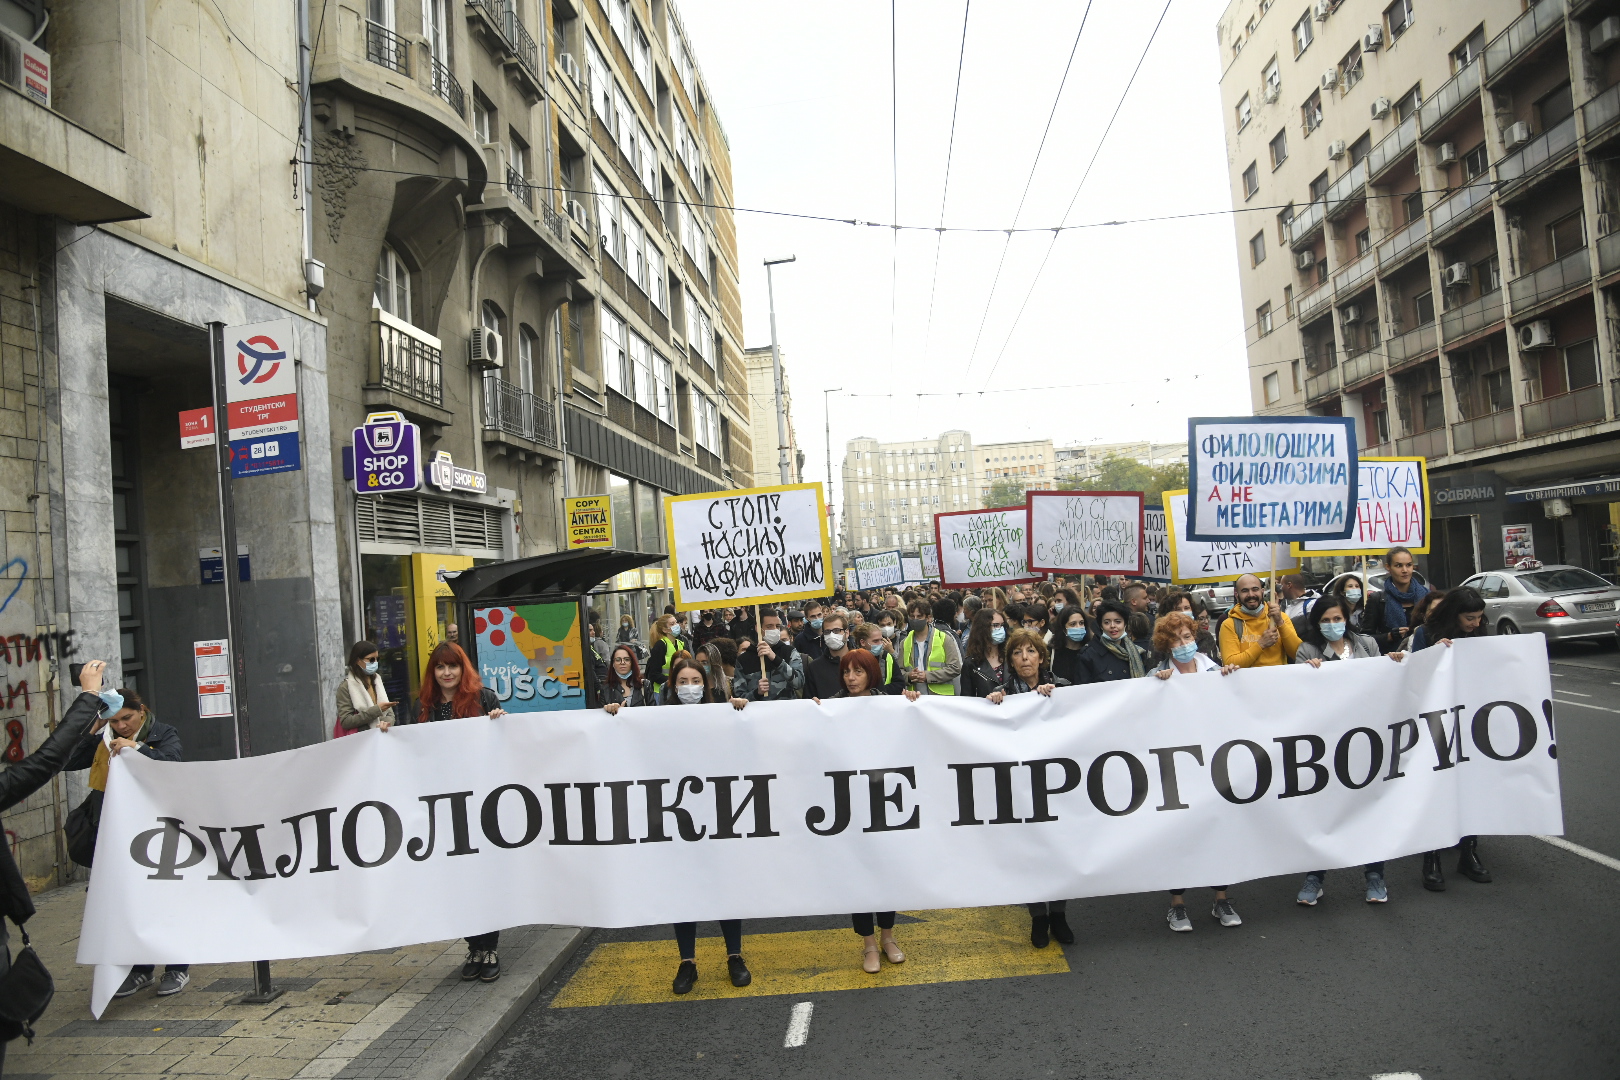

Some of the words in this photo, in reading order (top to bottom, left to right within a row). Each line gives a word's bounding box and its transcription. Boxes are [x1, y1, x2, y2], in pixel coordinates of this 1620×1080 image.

[25, 58, 47, 77] Galanz
[240, 401, 286, 414] СТУДЕНТСКИ
[257, 413, 270, 421] ТРГ
[201, 414, 208, 428] 1
[253, 447, 262, 455] 28
[1201, 432, 1335, 459] ФИЛОЛОШКИ
[363, 455, 408, 471] SHOP
[367, 471, 404, 487] &GO
[454, 471, 485, 489] SHOP&GO
[1211, 461, 1348, 485] ФИЛОЛОЗИМА
[1357, 466, 1420, 500] ЕТСКА
[1208, 485, 1222, 502] А
[1231, 486, 1254, 503] НЕ
[1436, 486, 1495, 503] ОДБРАНА
[1525, 486, 1587, 501] СУВЕНИРНИЦА
[575, 499, 600, 508] COPY
[708, 494, 781, 530] СТОП!
[1066, 497, 1084, 520] КО
[1090, 498, 1108, 520] СУ
[572, 507, 607, 526] ANTIKA
[968, 512, 1009, 531] ДАНАС
[1216, 500, 1343, 529] МЕШЕТАРИМА
[1357, 502, 1422, 543] НАША
[573, 527, 606, 536] CENTAR
[1059, 519, 1134, 544] МИЛИОНЕРИ
[701, 525, 787, 560] НАСИЉУ
[1037, 541, 1048, 562] С
[968, 544, 1010, 566] СУТРА
[1201, 551, 1254, 572] ZITTA
[680, 562, 720, 594] НАД
[483, 662, 521, 680] tvoje
[490, 667, 582, 702] UŠĆE
[129, 773, 780, 882] ФИЛОЛОШКИ
[804, 766, 921, 837] ЈЕ
[947, 698, 1558, 829] ПРОГОВОРИО!
